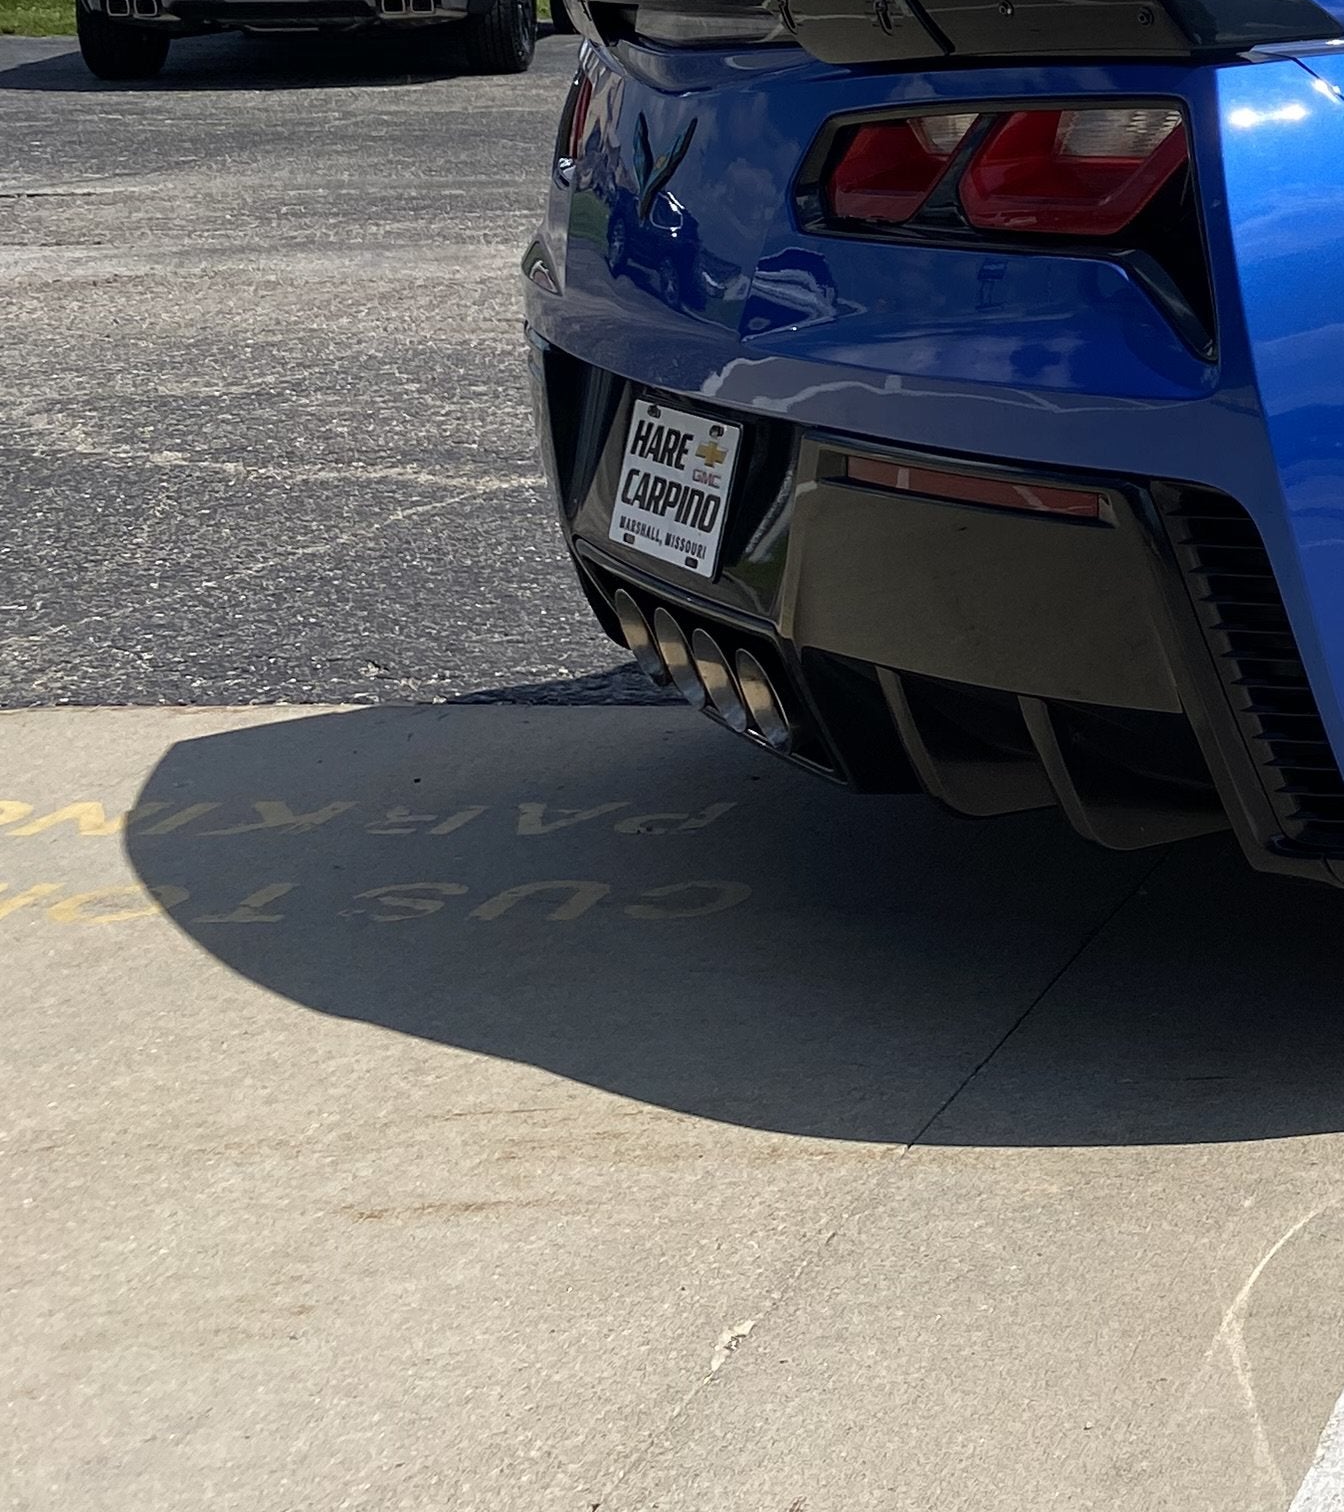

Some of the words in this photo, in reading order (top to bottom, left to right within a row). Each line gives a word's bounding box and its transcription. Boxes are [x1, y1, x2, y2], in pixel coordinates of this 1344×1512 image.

[629, 419, 695, 471] HARE
[620, 468, 722, 534] CARPINO
[692, 468, 722, 489] GMC
[619, 515, 663, 547] MARSHALL,
[664, 532, 707, 560] MISSOURI
